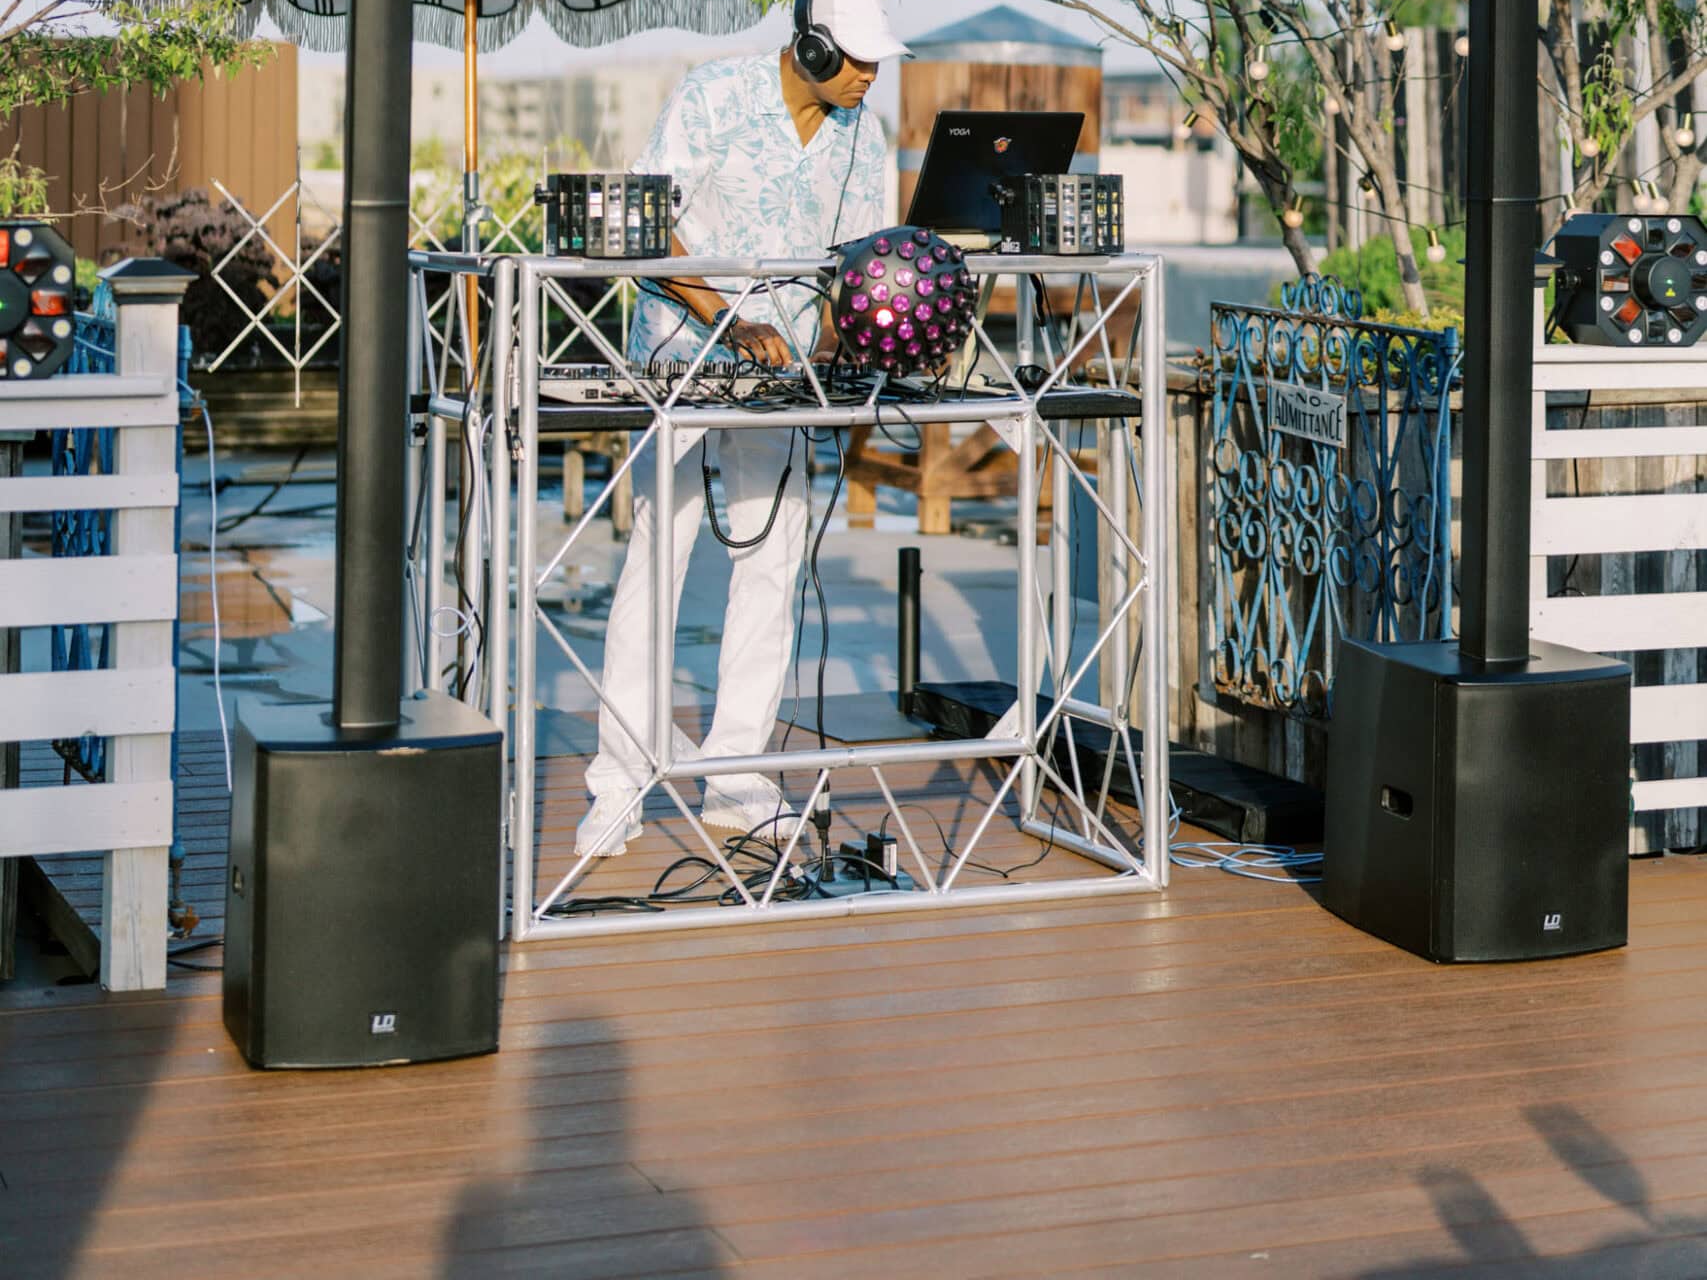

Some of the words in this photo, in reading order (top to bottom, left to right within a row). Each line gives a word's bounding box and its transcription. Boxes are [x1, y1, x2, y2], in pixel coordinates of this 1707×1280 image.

[949, 127, 971, 136] YOGA
[1275, 390, 1343, 442] ADMITTANCE
[1543, 914, 1561, 927] LD
[372, 1014, 396, 1029] LD
